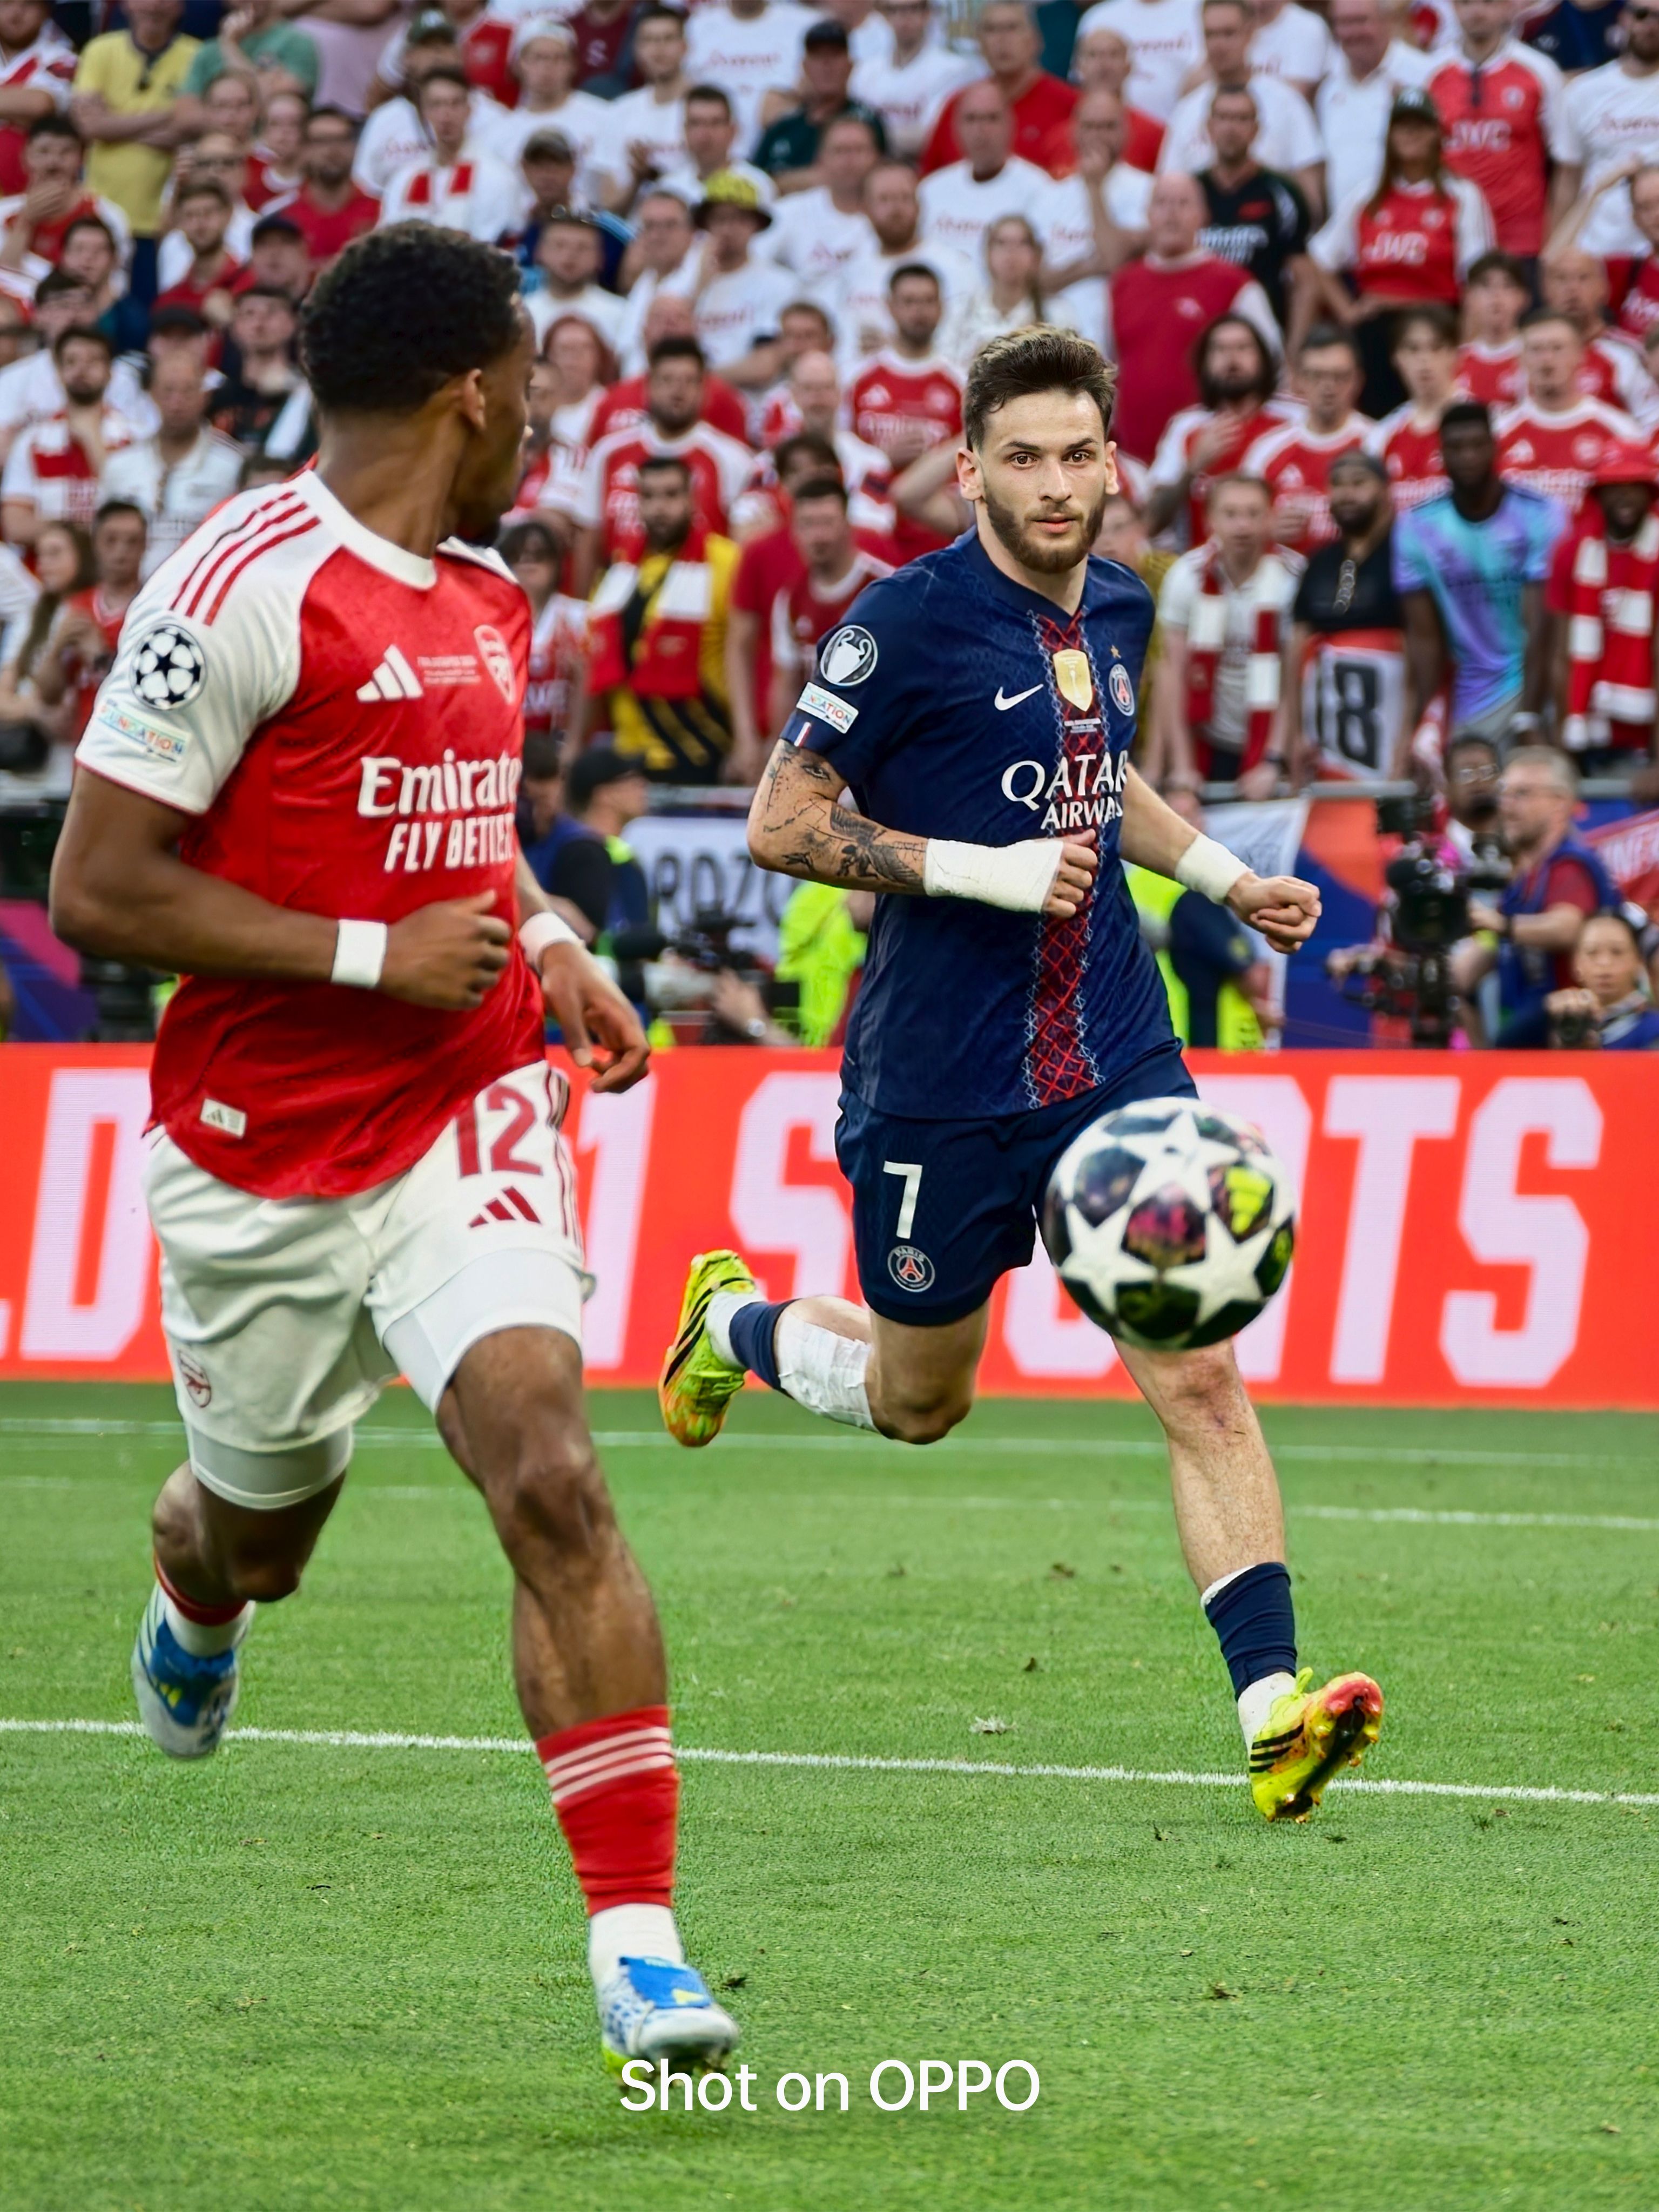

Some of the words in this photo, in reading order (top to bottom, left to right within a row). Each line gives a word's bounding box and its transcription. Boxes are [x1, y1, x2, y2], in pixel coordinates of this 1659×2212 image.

[1001, 750, 1129, 811] QATAR
[384, 822, 442, 873] FLY
[457, 1085, 543, 1179] 12
[882, 1160, 923, 1239] 7
